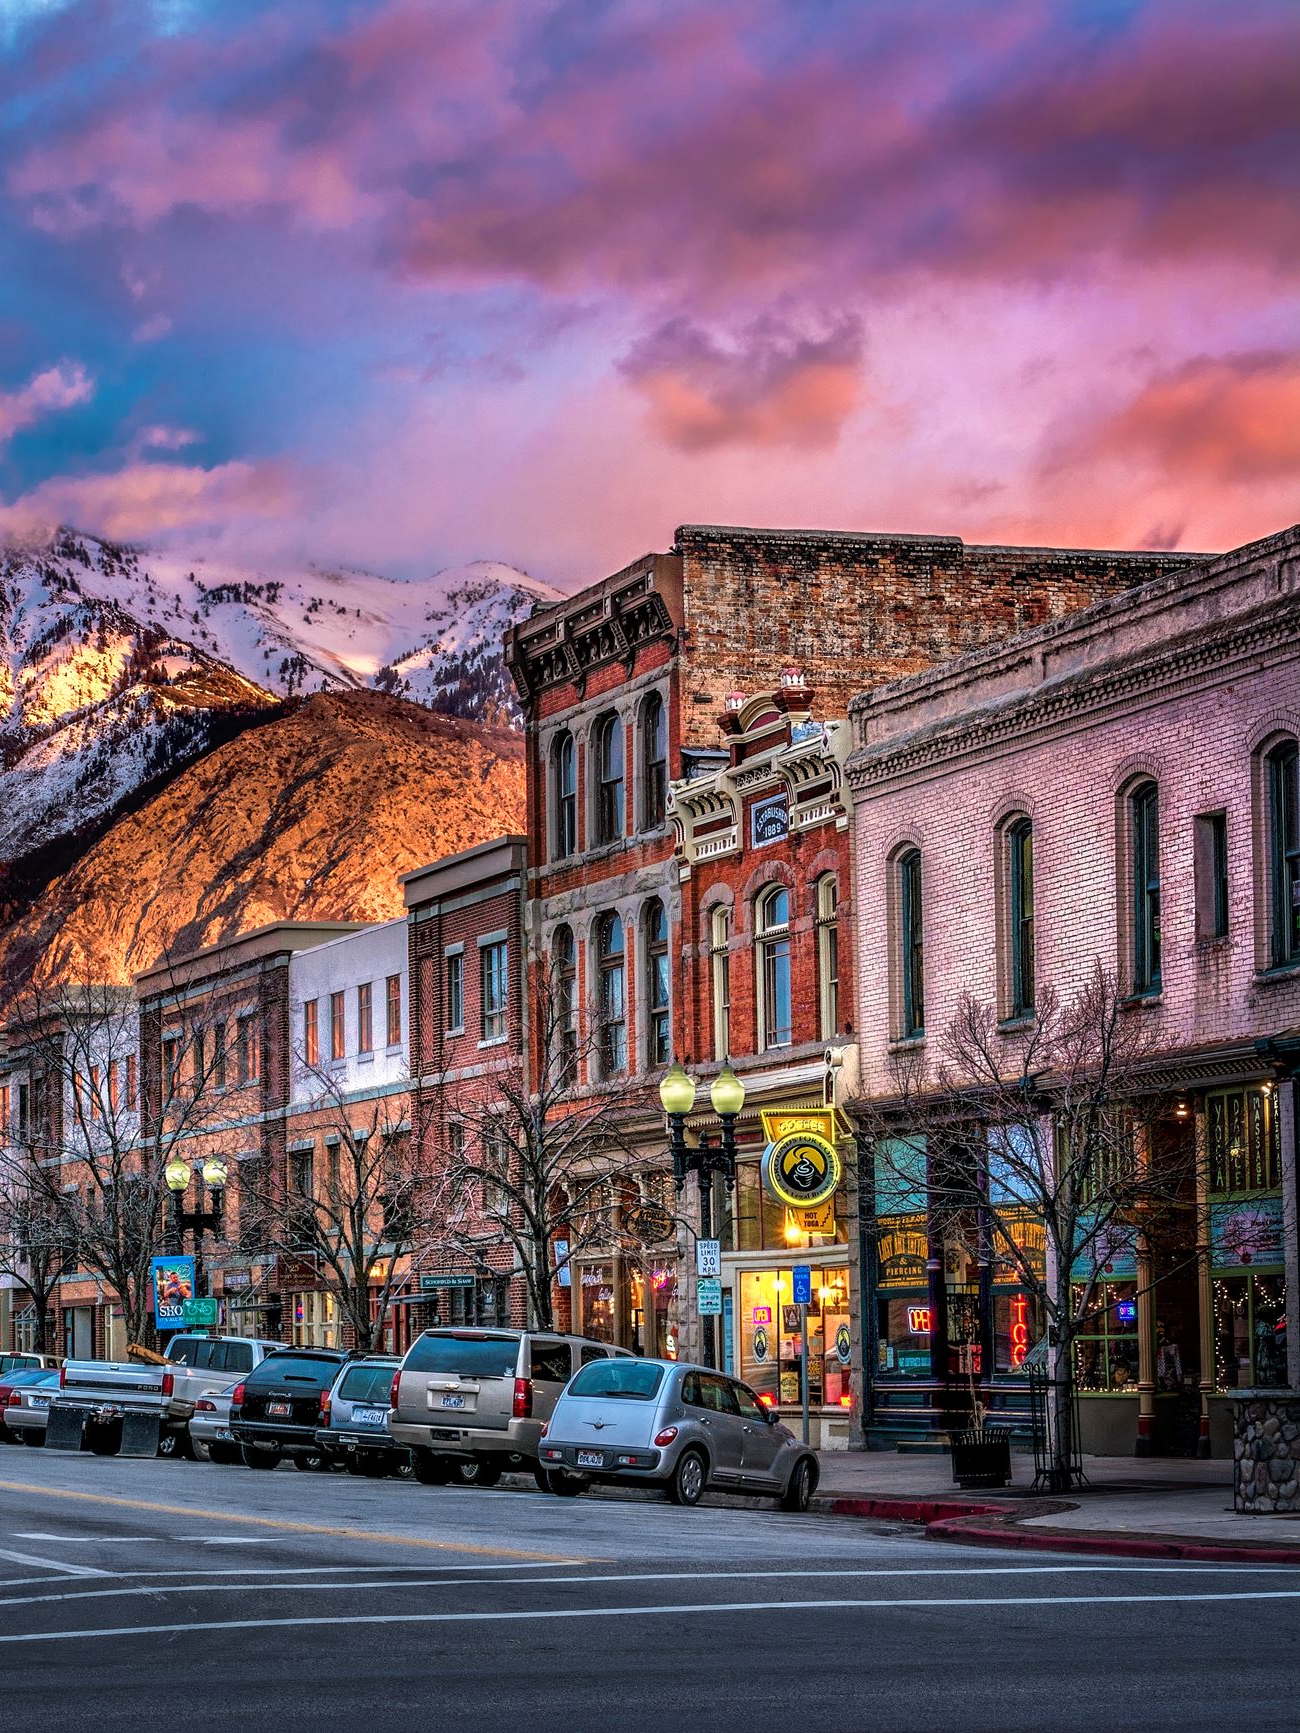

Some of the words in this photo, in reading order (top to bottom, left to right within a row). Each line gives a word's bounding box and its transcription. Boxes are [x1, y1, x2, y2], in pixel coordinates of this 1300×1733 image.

[757, 807, 788, 832] ESTABLISHED
[765, 823, 781, 838] 1889
[1272, 1091, 1281, 1150] HEALING
[1214, 1103, 1225, 1187] YOGA
[1233, 1099, 1242, 1186] DANCE
[1252, 1096, 1262, 1185] MASSAGE
[773, 1136, 799, 1182] GROUNDS
[799, 1134, 818, 1144] FOR
[790, 1190, 811, 1201] Legal
[804, 1212, 818, 1220] HOT
[803, 1220, 820, 1228] YOGA
[699, 1242, 719, 1250] SPEED
[702, 1257, 716, 1267] 30
[899, 1257, 908, 1266] &
[885, 1266, 923, 1277] PIERCING
[697, 1280, 706, 1292] 2
[159, 1305, 184, 1317] SHO
[137, 1384, 159, 1392] FORD
